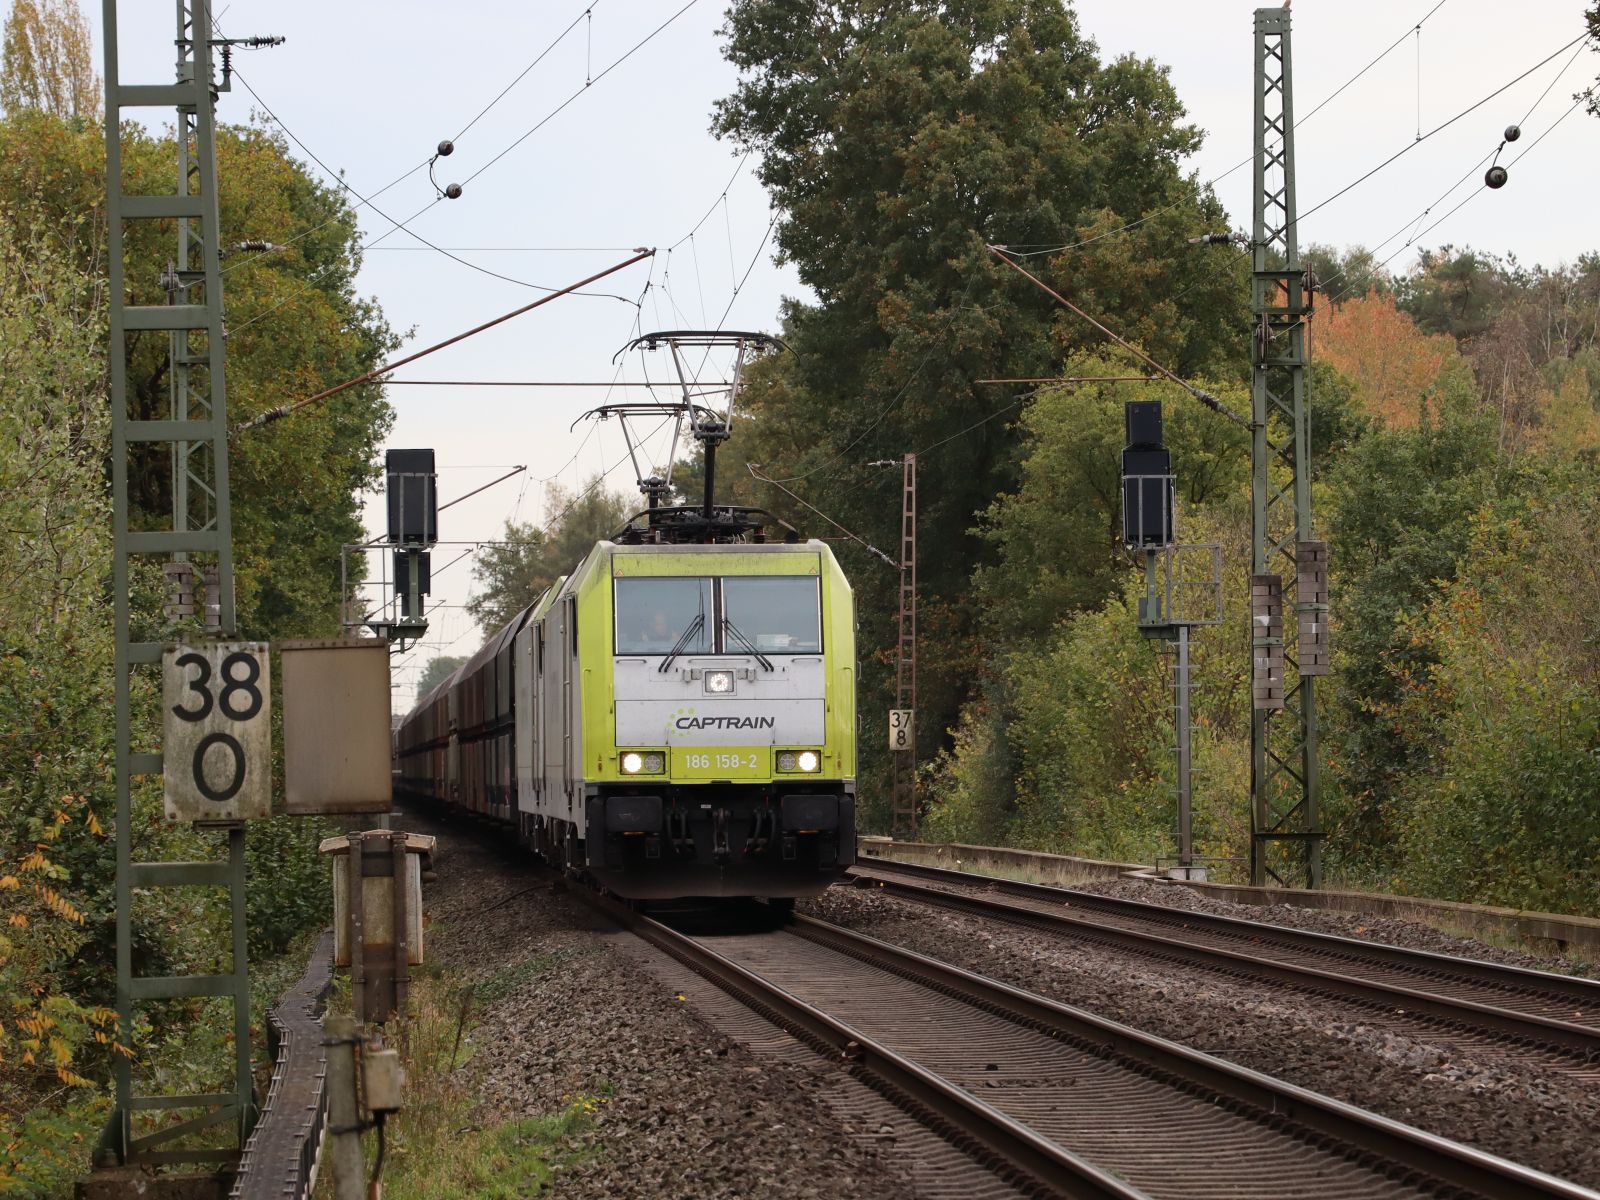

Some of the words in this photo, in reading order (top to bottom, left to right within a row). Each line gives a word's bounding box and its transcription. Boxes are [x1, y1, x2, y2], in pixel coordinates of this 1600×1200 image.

[171, 652, 263, 722] 38
[675, 716, 775, 730] CAPTRAIN
[891, 711, 912, 728] 37
[896, 730, 907, 746] 8
[192, 732, 246, 802] 0
[685, 754, 710, 769] 186
[715, 754, 757, 769] 158-2
